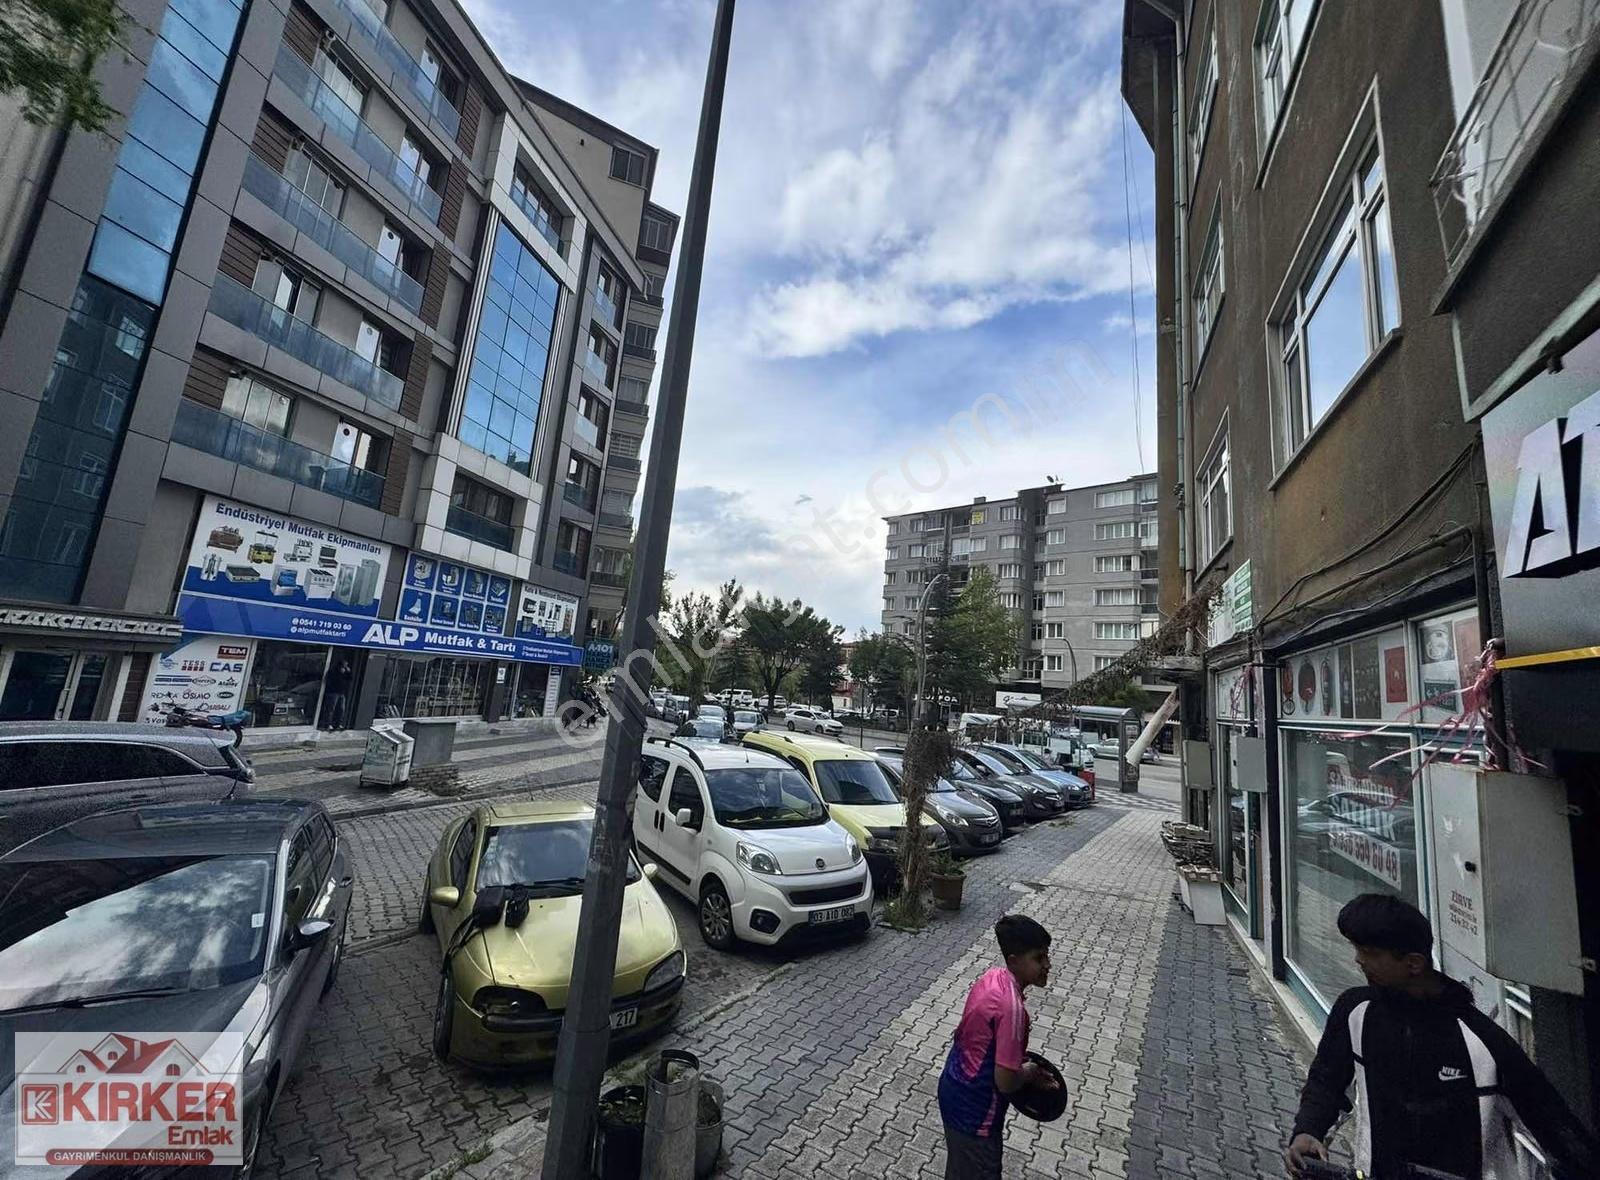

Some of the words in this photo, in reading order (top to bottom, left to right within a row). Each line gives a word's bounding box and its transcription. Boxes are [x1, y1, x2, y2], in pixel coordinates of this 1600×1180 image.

[215, 502, 286, 530] Endüstriyel
[287, 522, 325, 540] Mutfak
[327, 533, 381, 555] Ekipmanları
[362, 623, 419, 646] ALP
[424, 631, 473, 649] Mutfak
[477, 638, 486, 649] &
[490, 639, 516, 652] Tartı
[209, 662, 243, 672] CAS
[616, 1009, 635, 1027] 217
[1441, 1065, 1461, 1076] NIKE
